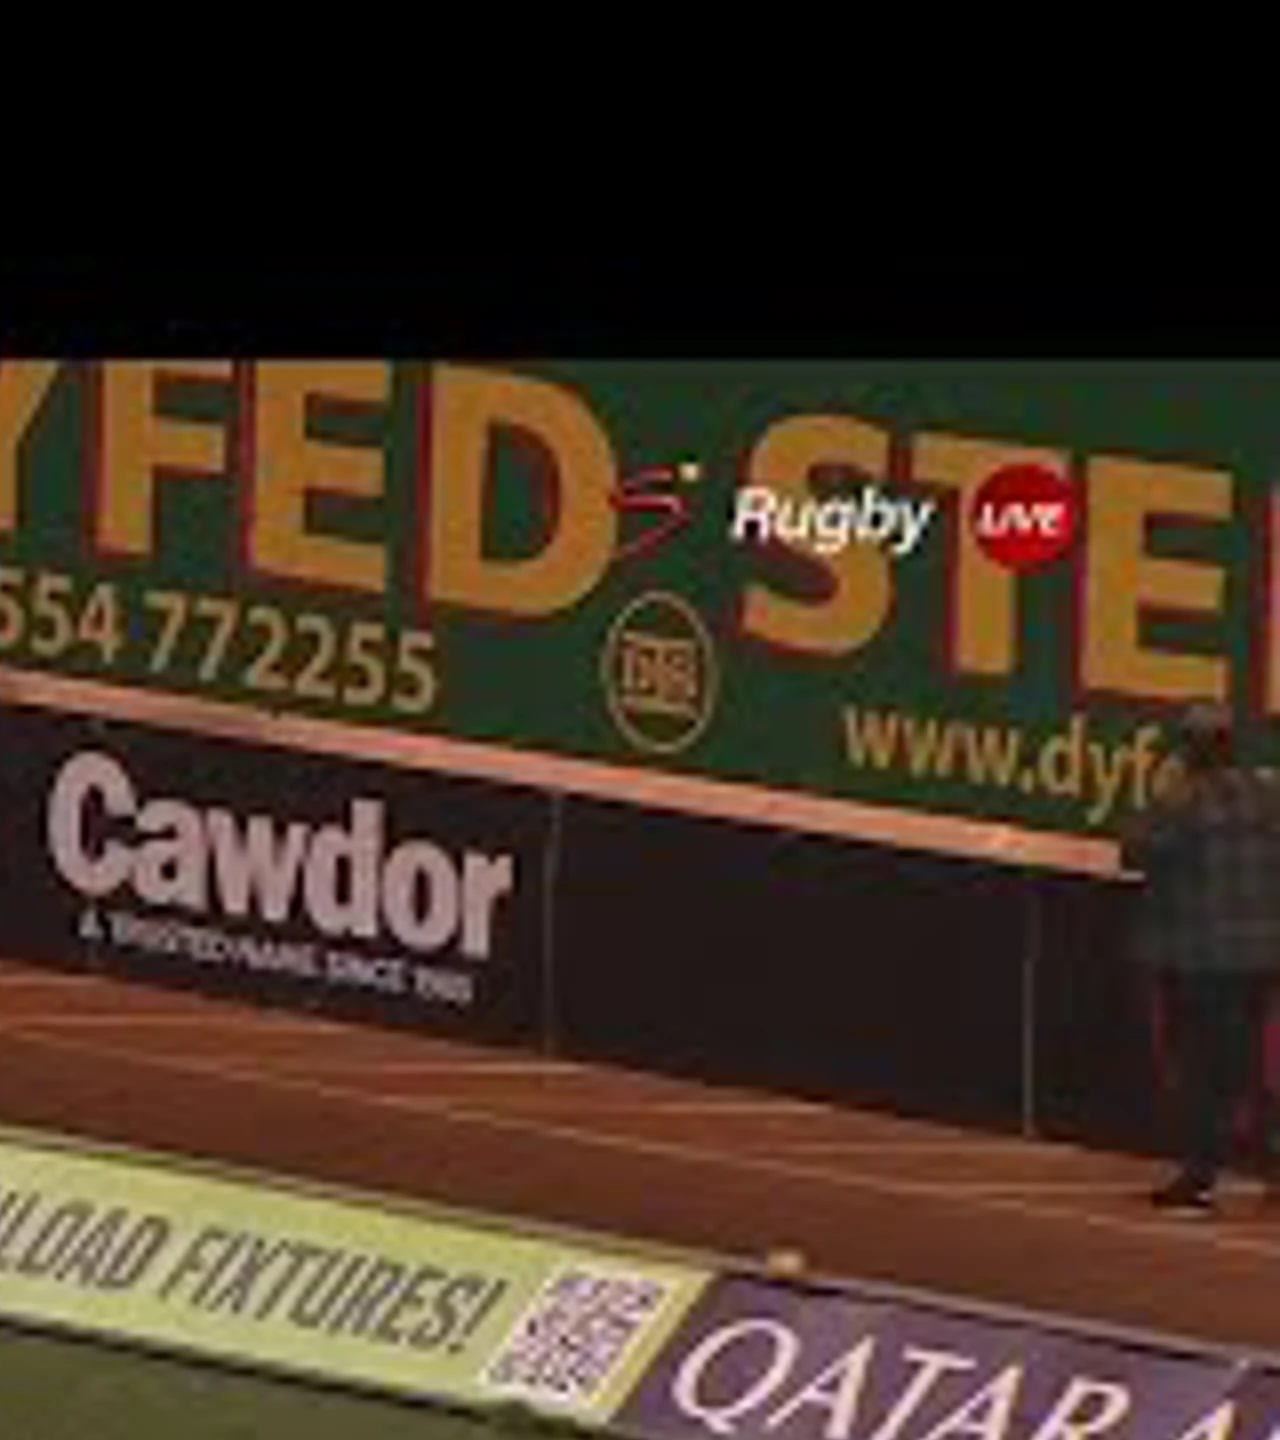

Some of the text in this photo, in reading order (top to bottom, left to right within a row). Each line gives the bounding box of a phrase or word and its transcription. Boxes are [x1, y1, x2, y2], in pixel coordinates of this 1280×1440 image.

[740, 413, 1280, 718] STE
[143, 591, 437, 714] 772255
[48, 750, 513, 960] Cawdor
[159, 1225, 513, 1354] FIXTURES!
